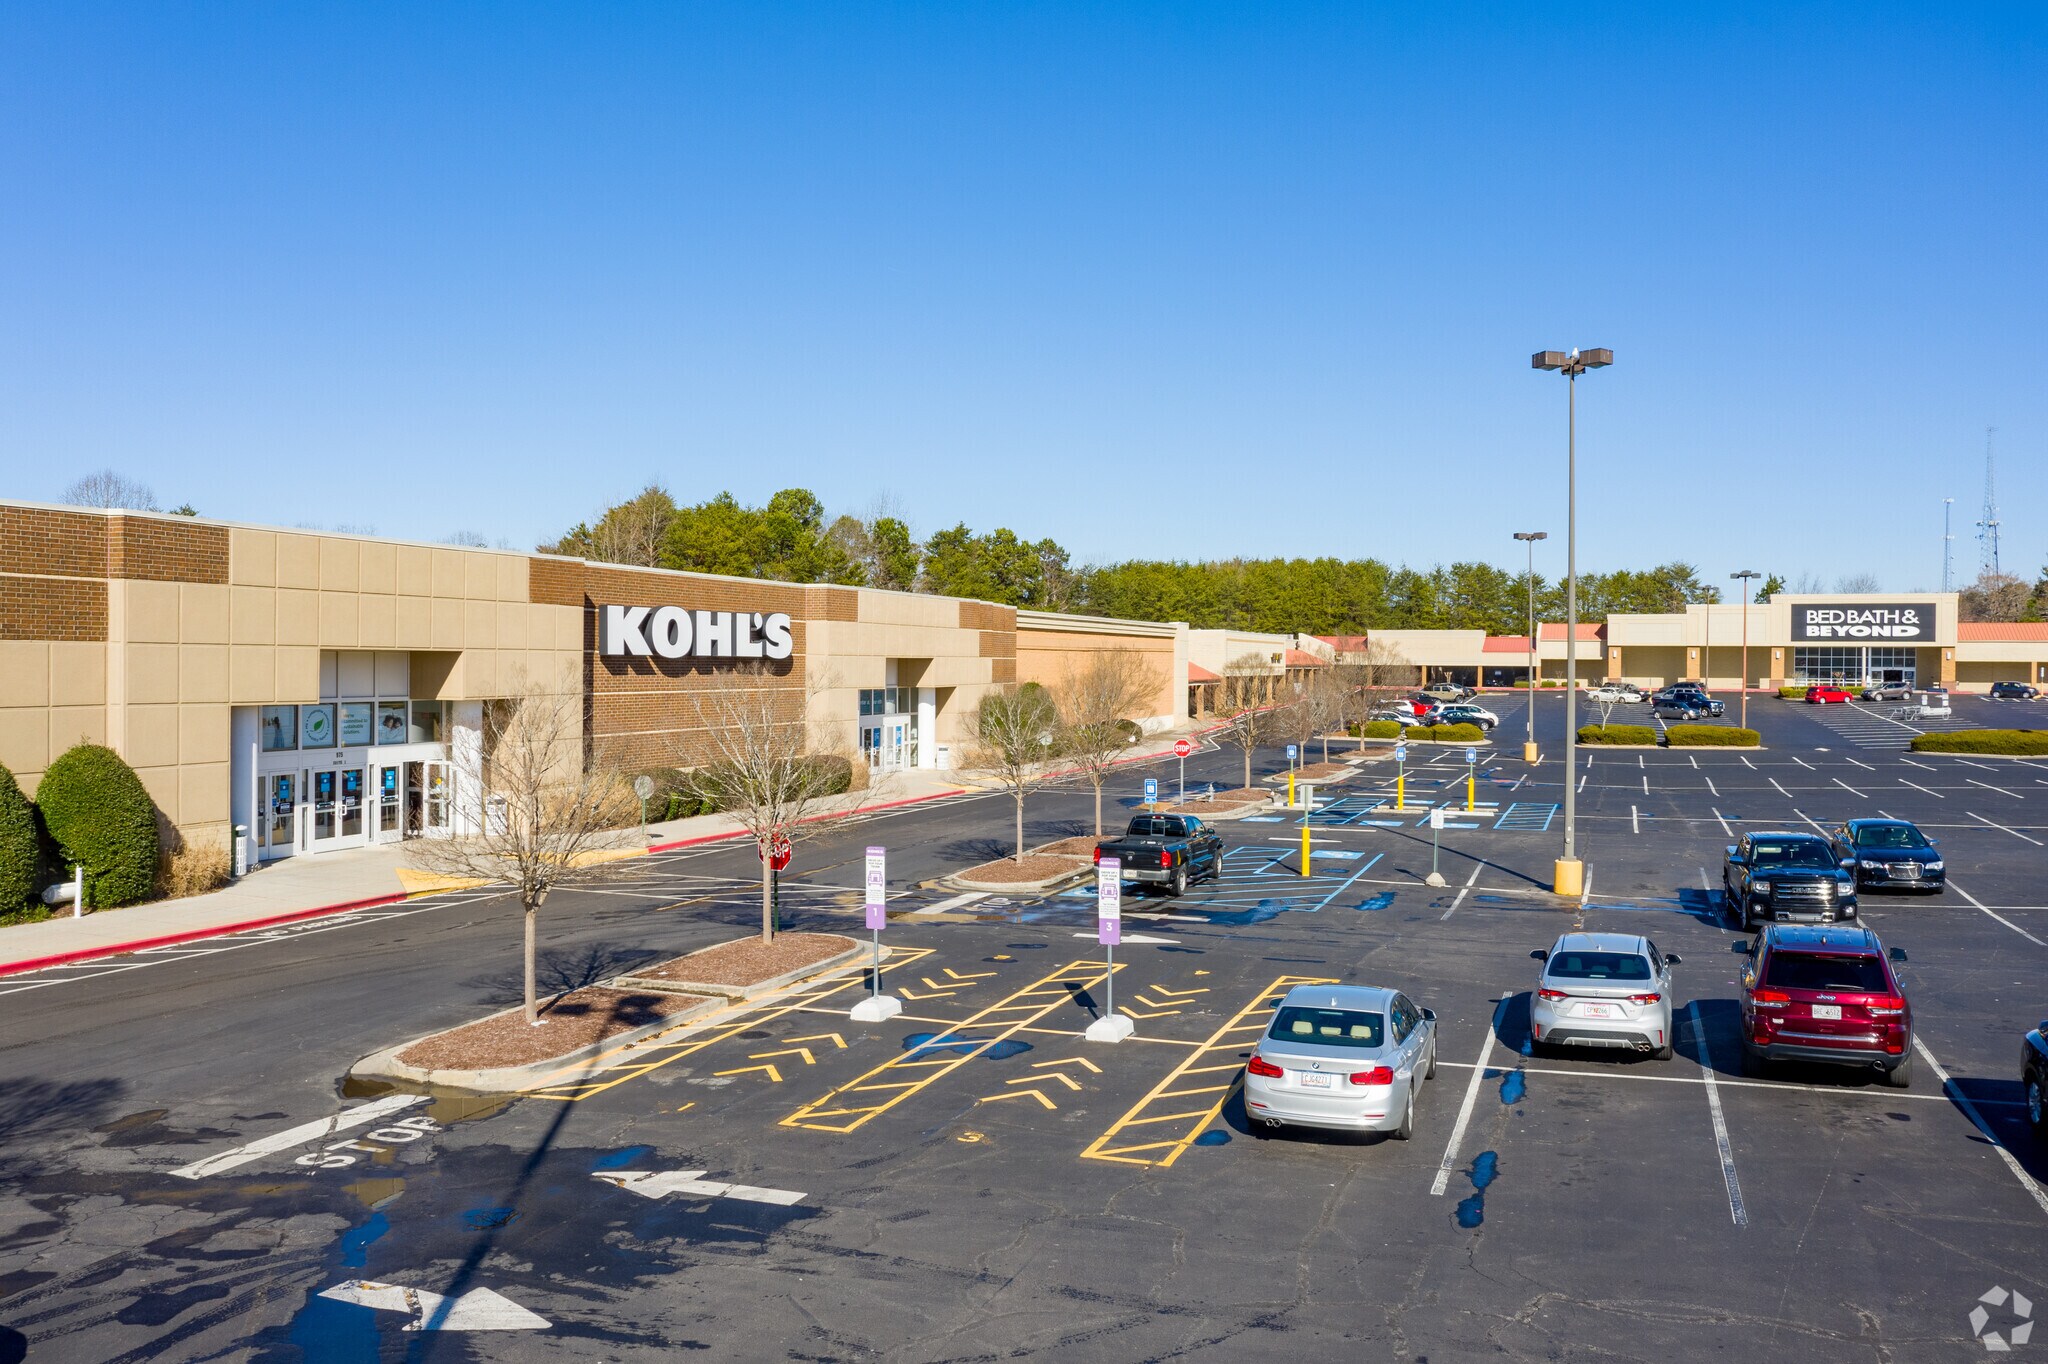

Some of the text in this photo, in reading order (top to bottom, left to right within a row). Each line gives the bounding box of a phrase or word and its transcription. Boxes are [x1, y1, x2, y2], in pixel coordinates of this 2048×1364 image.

[1806, 609, 1920, 624] BED BATH &
[604, 604, 793, 660] KOHL'S
[1806, 625, 1920, 637] BEYOND
[1174, 744, 1190, 753] STOP
[873, 907, 878, 917] 1
[1106, 922, 1113, 931] 3
[295, 1116, 443, 1168] STOP
